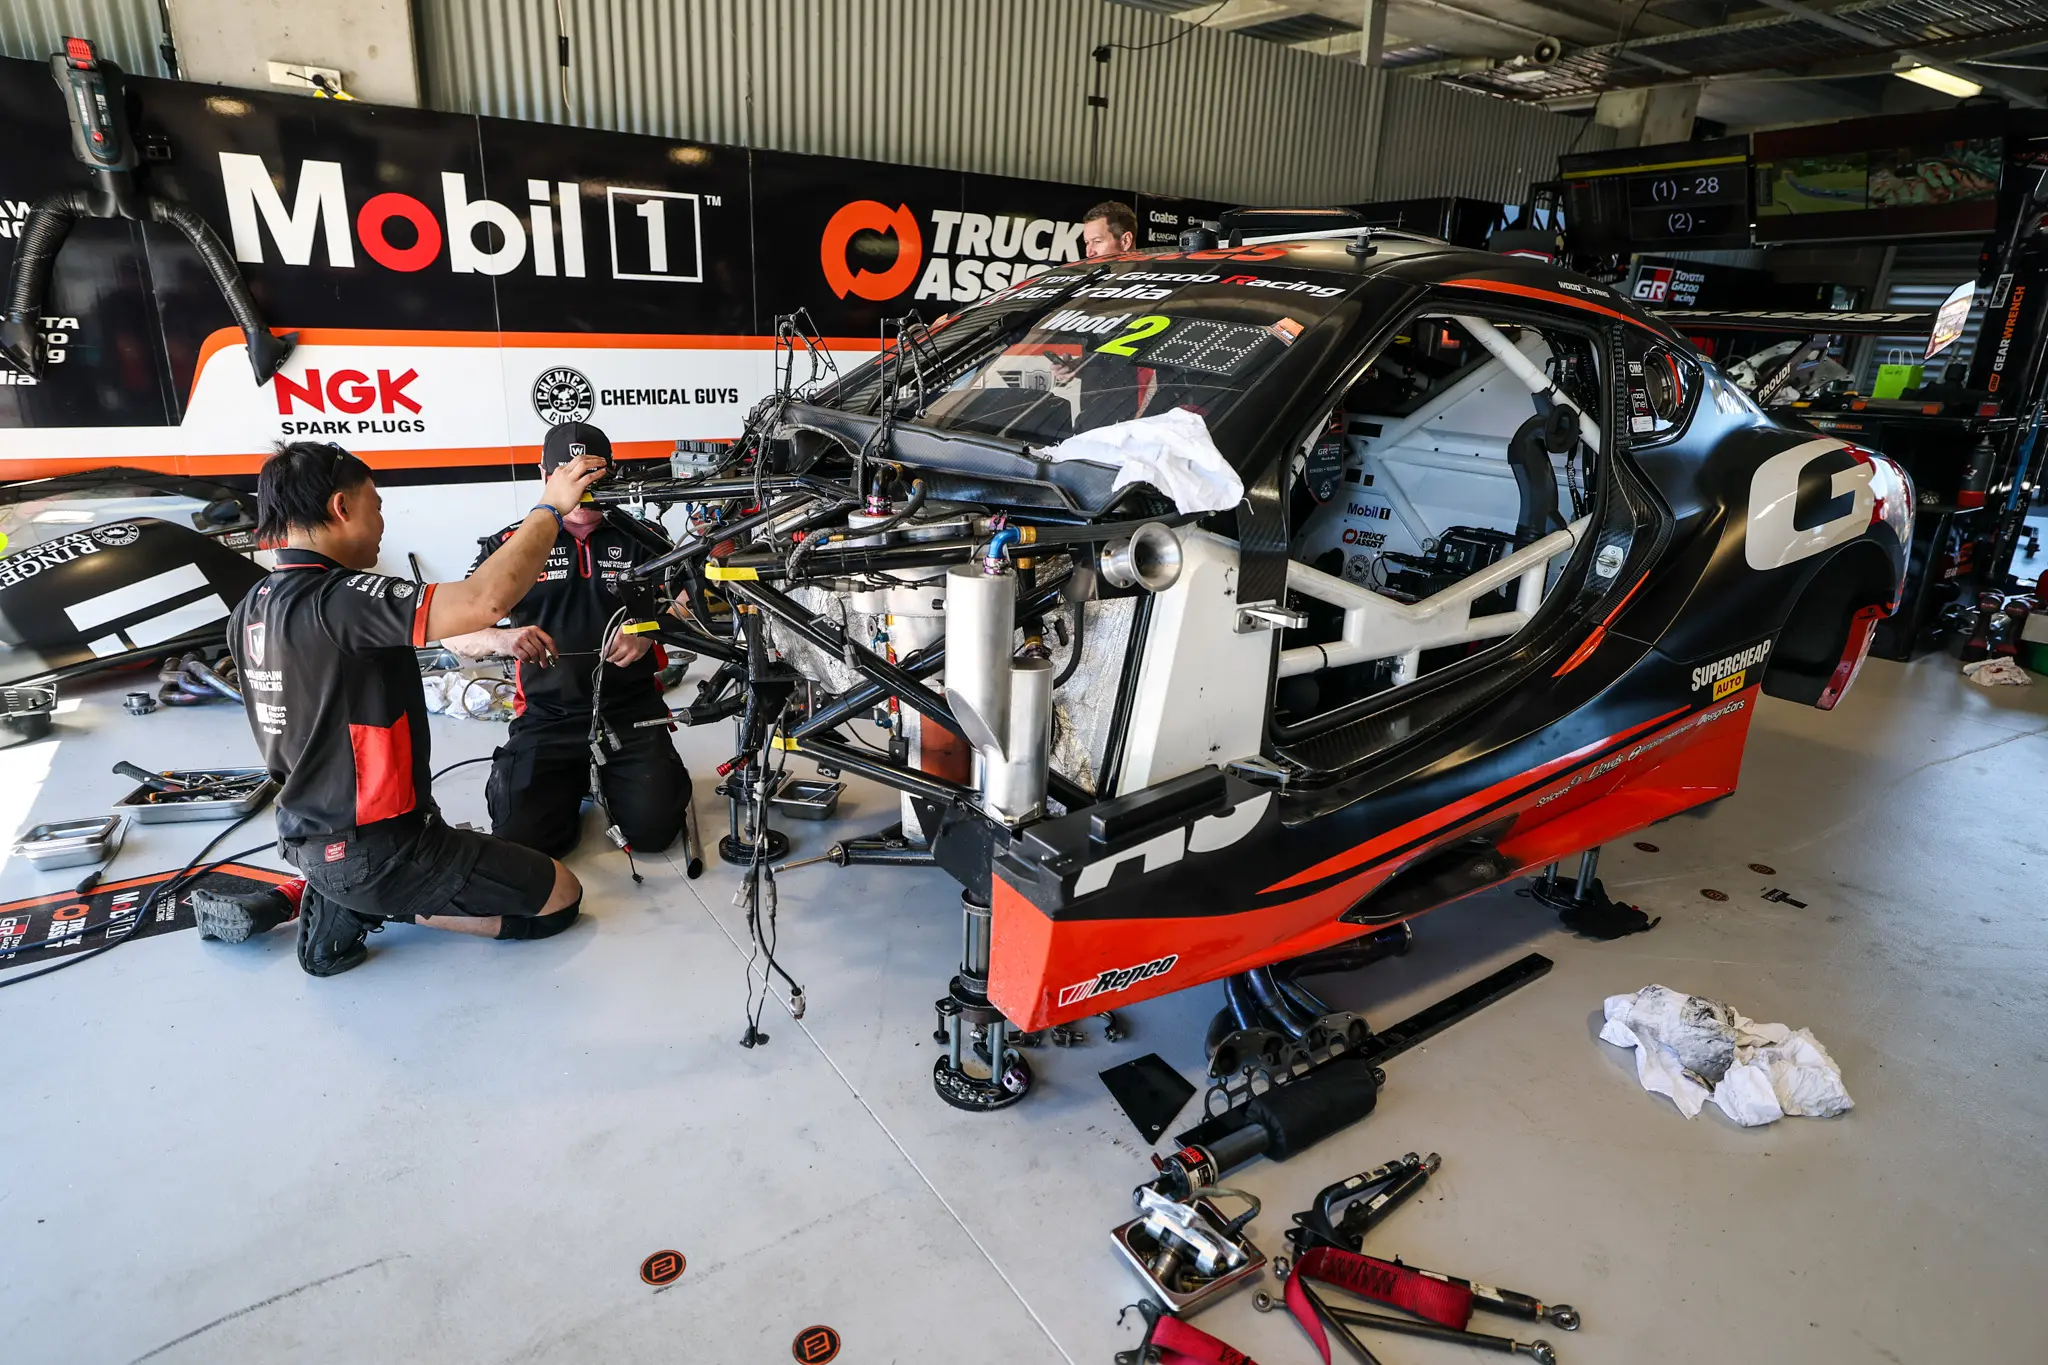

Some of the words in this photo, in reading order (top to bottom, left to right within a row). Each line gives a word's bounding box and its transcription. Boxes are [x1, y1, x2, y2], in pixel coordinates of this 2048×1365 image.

[1652, 180, 1677, 202] (1)
[1695, 177, 1720, 195] 28
[219, 152, 586, 279] Mobil
[1150, 211, 1178, 225] Coates
[1668, 213, 1693, 232] (2)
[931, 210, 1083, 262] TRUCK
[1116, 271, 1220, 283] GAZOO
[1220, 275, 1346, 299] Racing
[1675, 270, 1705, 283] TOYOTA
[1634, 279, 1668, 299] GR
[1671, 281, 1700, 293] GAZOO
[1039, 310, 1133, 334] Wood
[1993, 286, 2026, 372] GEARWRENCH
[1095, 316, 1171, 356] 2
[1628, 364, 1643, 373] OMP
[273, 368, 422, 415] NGK
[601, 389, 690, 405] CHEMICAL
[695, 388, 738, 404] GUYS
[281, 421, 352, 435] SPARK
[357, 420, 425, 433] PLUGS
[1347, 502, 1379, 518] Mobil
[1355, 538, 1384, 549] ASSIST
[1358, 530, 1388, 541] TRUCK
[1691, 639, 1772, 692] SUPERCHEAP
[1715, 675, 1742, 696] AUTO
[1088, 954, 1178, 998] Repco
